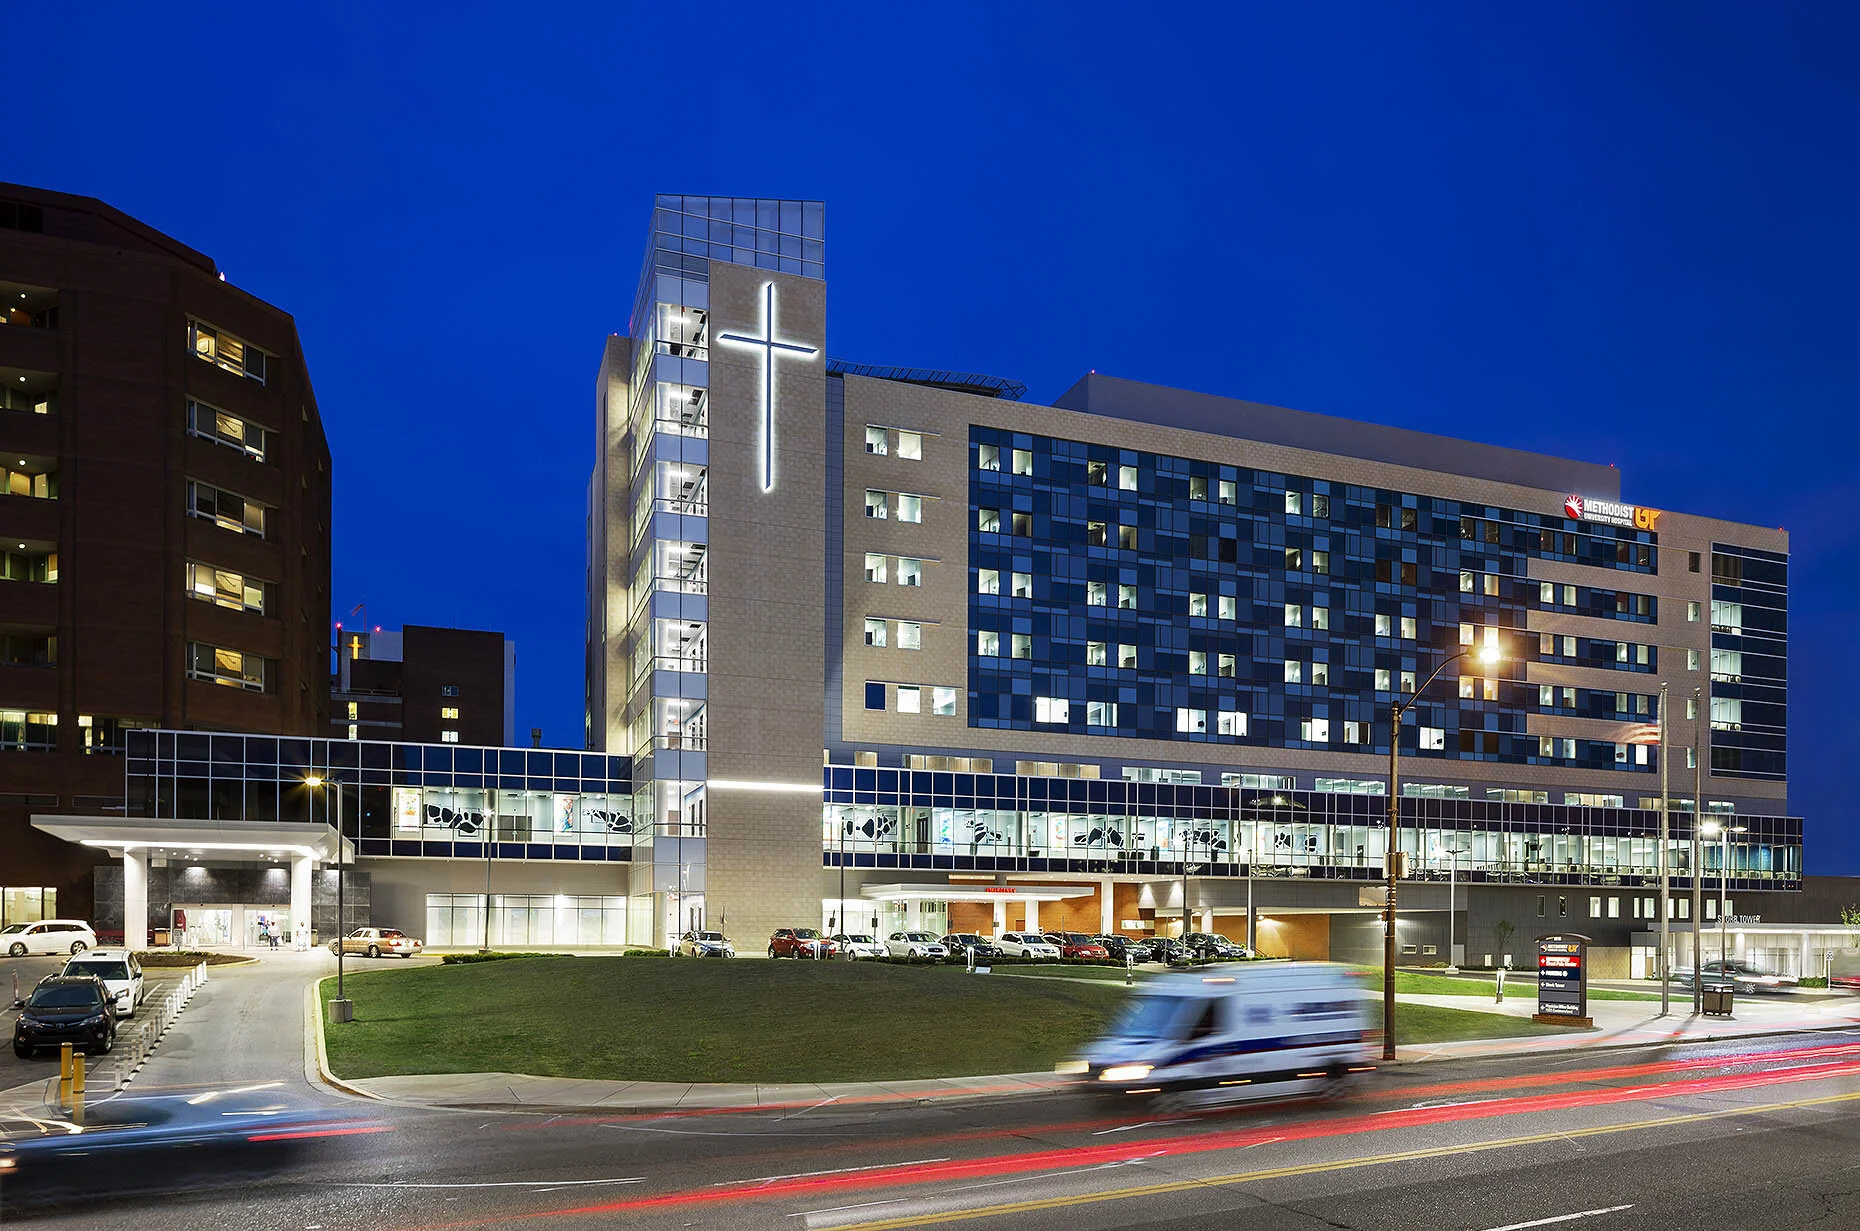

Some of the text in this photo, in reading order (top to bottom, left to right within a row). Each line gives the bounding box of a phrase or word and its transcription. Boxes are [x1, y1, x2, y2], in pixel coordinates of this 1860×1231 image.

[1584, 499, 1634, 519] METHODIST
[1584, 512, 1633, 527] UNIVERSITY HOSPITAL
[1635, 507, 1661, 530] UT
[1717, 914, 1761, 923] SORB TOWER
